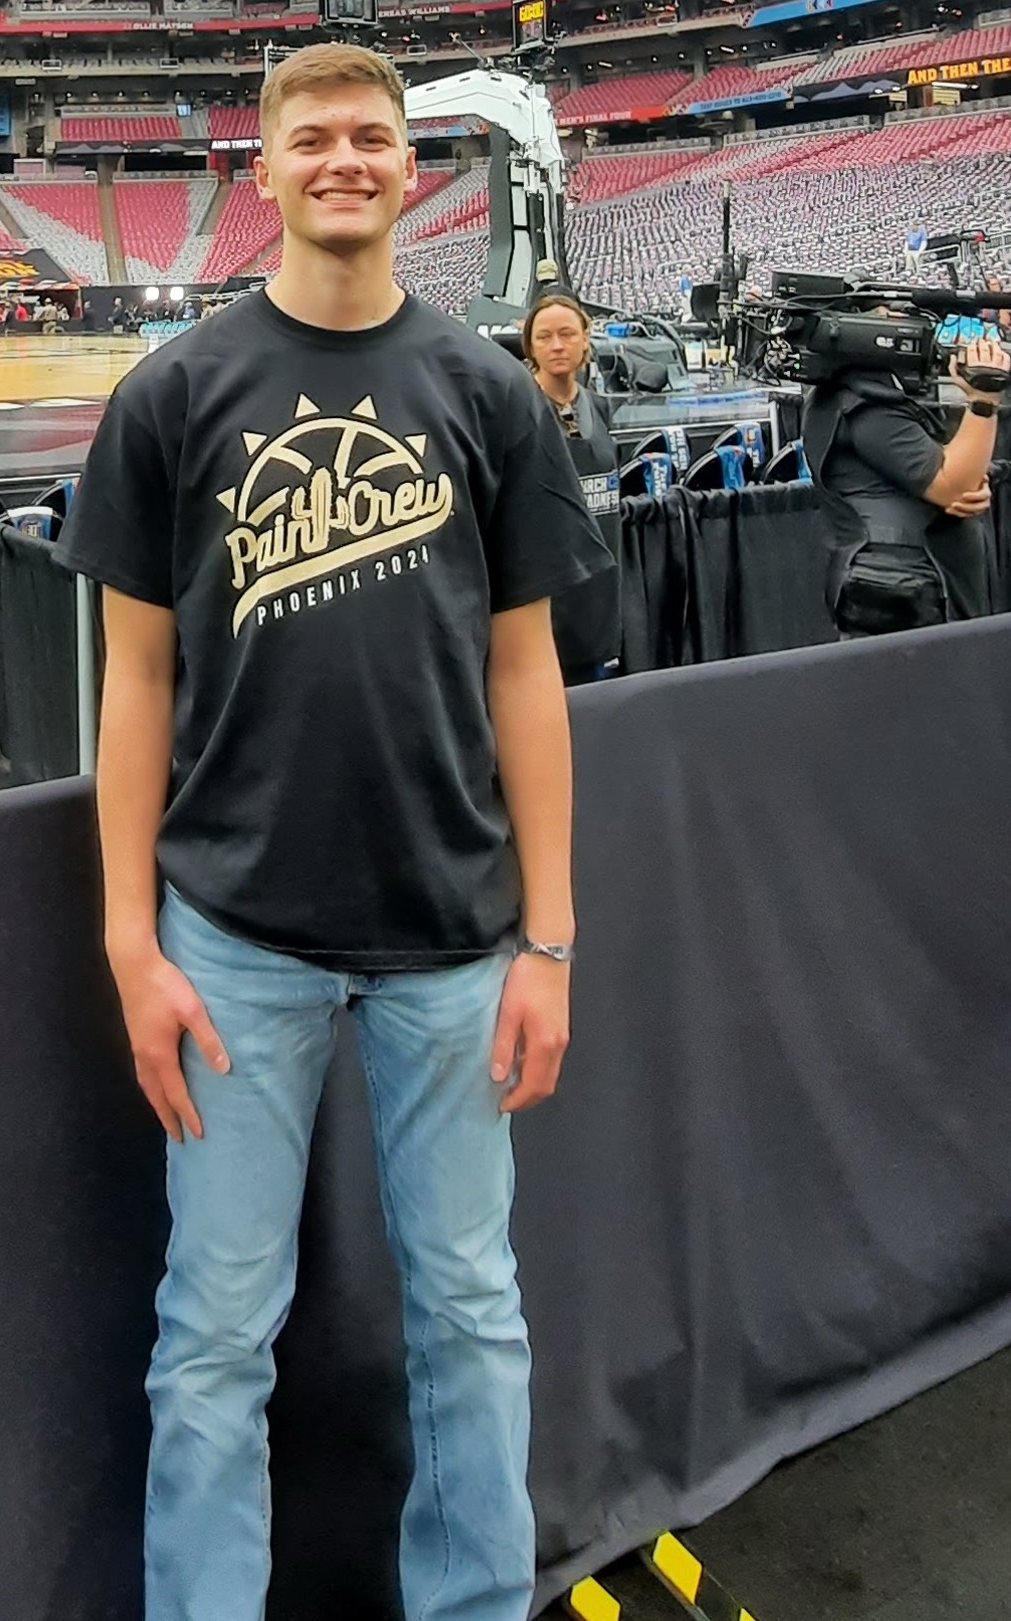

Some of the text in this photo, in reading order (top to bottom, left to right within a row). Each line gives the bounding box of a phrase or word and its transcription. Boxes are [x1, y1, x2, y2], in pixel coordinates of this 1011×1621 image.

[908, 68, 937, 85] AND
[940, 61, 978, 79] THEN
[257, 570, 362, 626] PHOENIX
